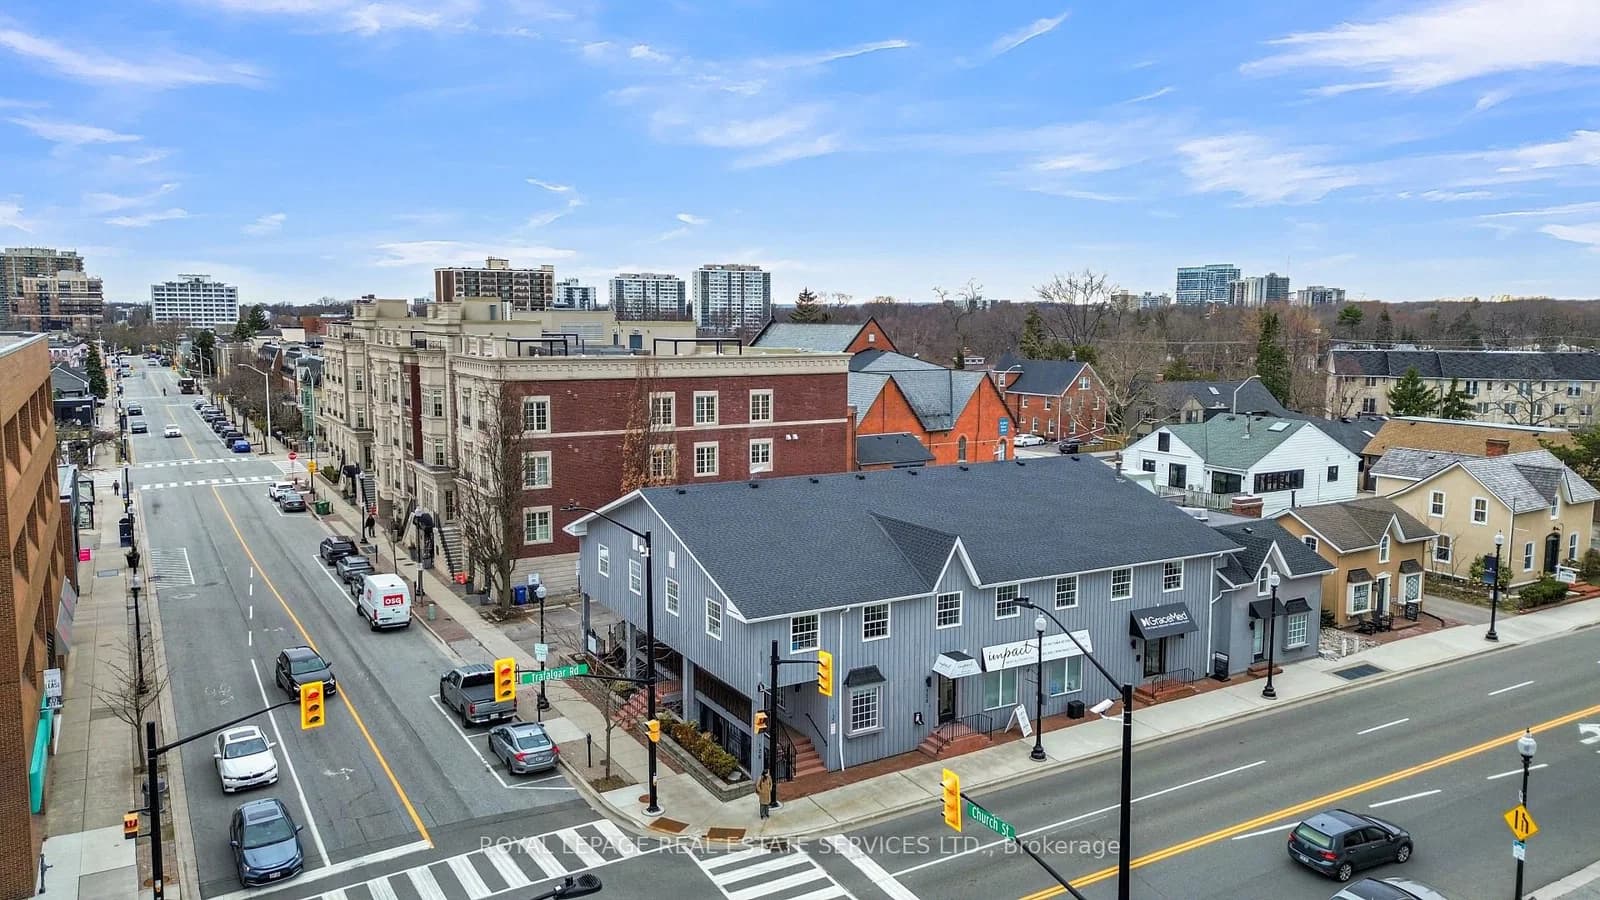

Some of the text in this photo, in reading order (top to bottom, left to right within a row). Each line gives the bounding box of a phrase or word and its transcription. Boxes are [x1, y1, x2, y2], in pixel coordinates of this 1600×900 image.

[1149, 611, 1188, 626] GraceMed
[988, 640, 1032, 668] impact
[532, 665, 579, 682] Trafalgar Rd
[972, 806, 1010, 837] Church St
